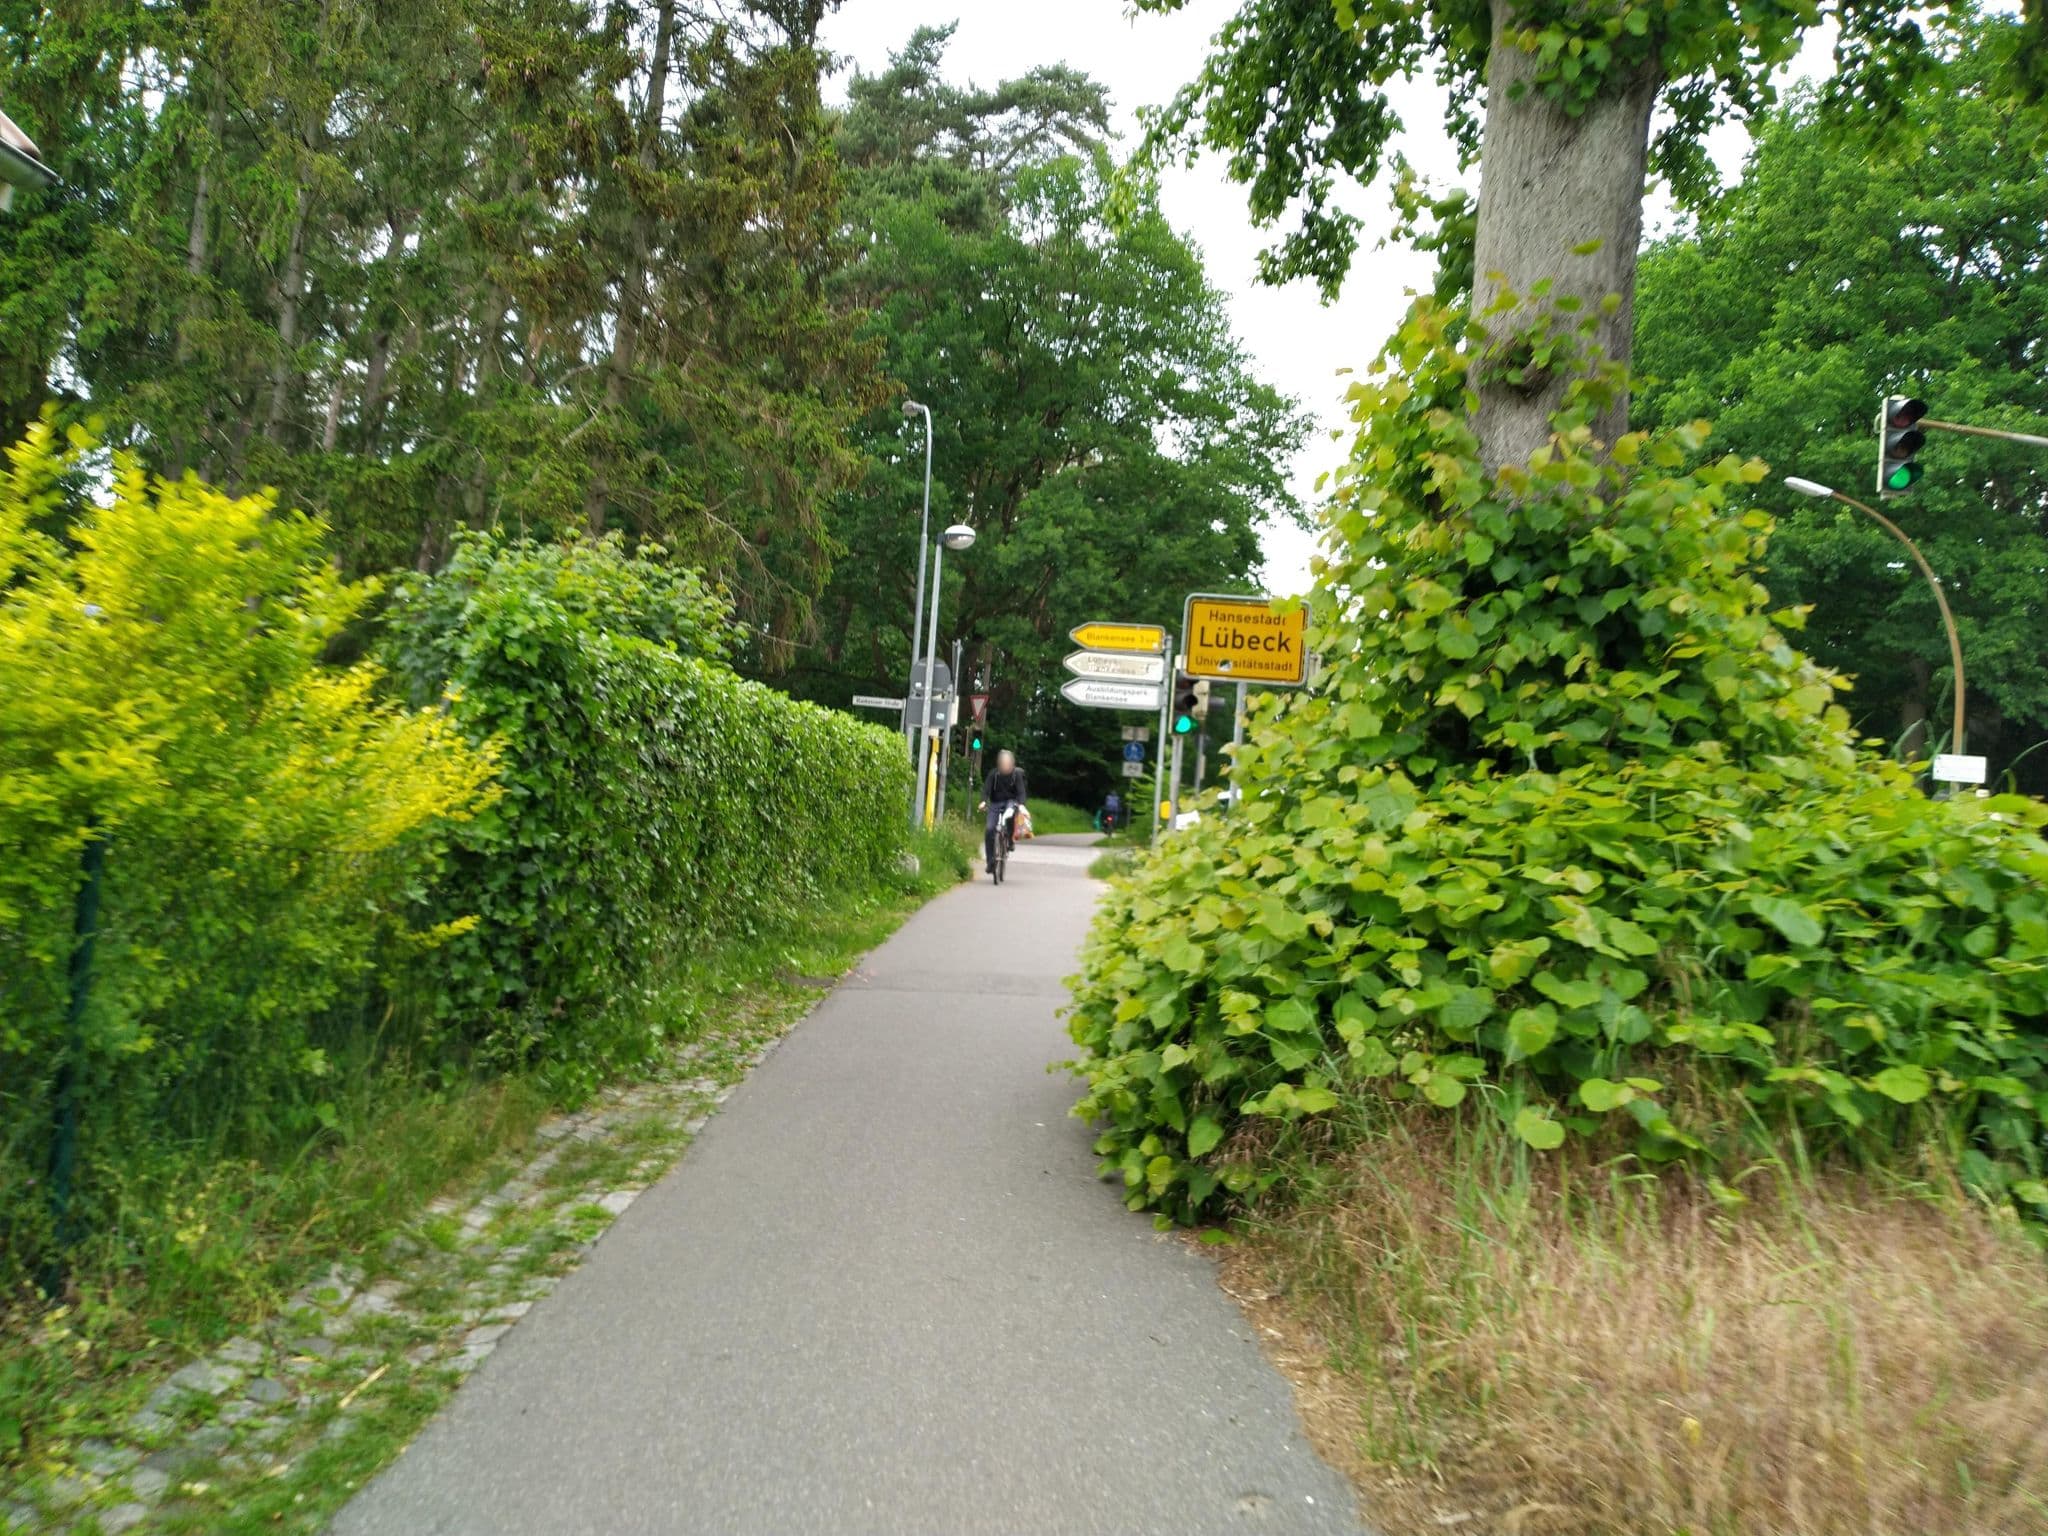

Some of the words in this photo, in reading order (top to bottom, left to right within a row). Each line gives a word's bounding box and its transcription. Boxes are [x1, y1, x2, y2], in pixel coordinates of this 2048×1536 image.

[1209, 610, 1286, 626] Hansestadt
[1199, 626, 1291, 653] Lübeck
[1195, 655, 1293, 672] Univsitätsstadt
